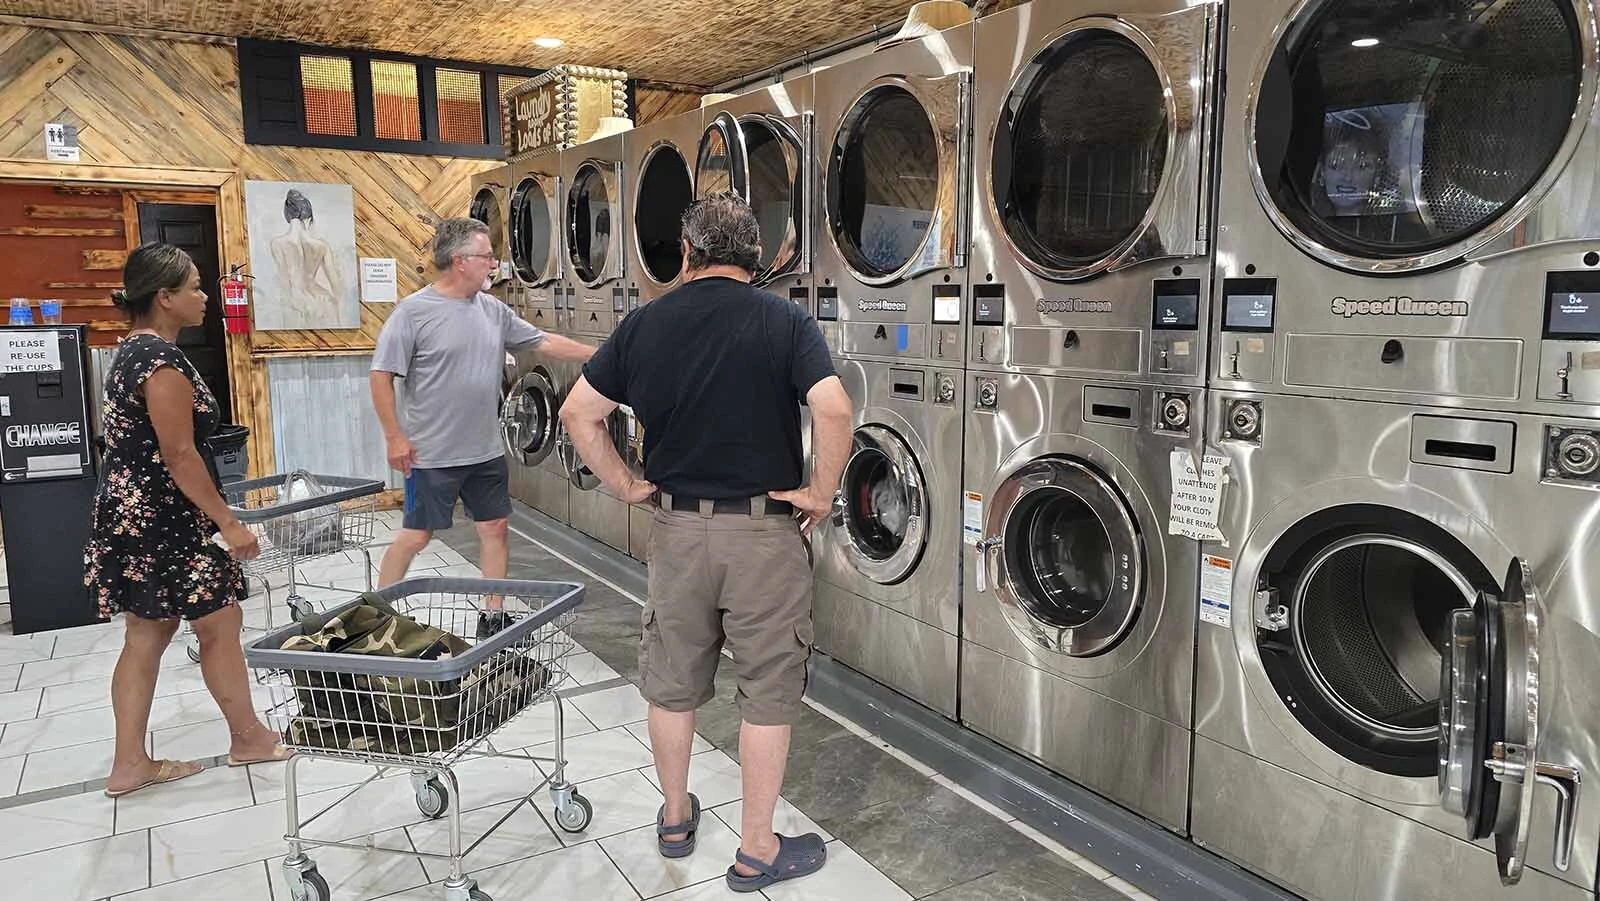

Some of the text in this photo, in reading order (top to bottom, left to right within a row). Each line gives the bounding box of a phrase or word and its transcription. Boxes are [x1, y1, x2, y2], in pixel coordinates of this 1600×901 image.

[515, 86, 551, 121] Laundry
[517, 127, 541, 152] Loads
[542, 122, 552, 144] of
[858, 299, 907, 313] Speed Queen
[1036, 298, 1113, 315] Speed Queen
[1331, 296, 1469, 318] Speed Queen
[8, 340, 46, 348] PLEASE
[10, 351, 46, 360] RE-USE
[26, 363, 54, 371] CUPS
[5, 421, 81, 447] CHANGE
[1202, 456, 1222, 465] LEAVE
[1176, 491, 1197, 502] AFTER
[1198, 495, 1207, 503] 10
[1173, 503, 1192, 513] YOUR
[1170, 514, 1216, 530] WILL BE REMO
